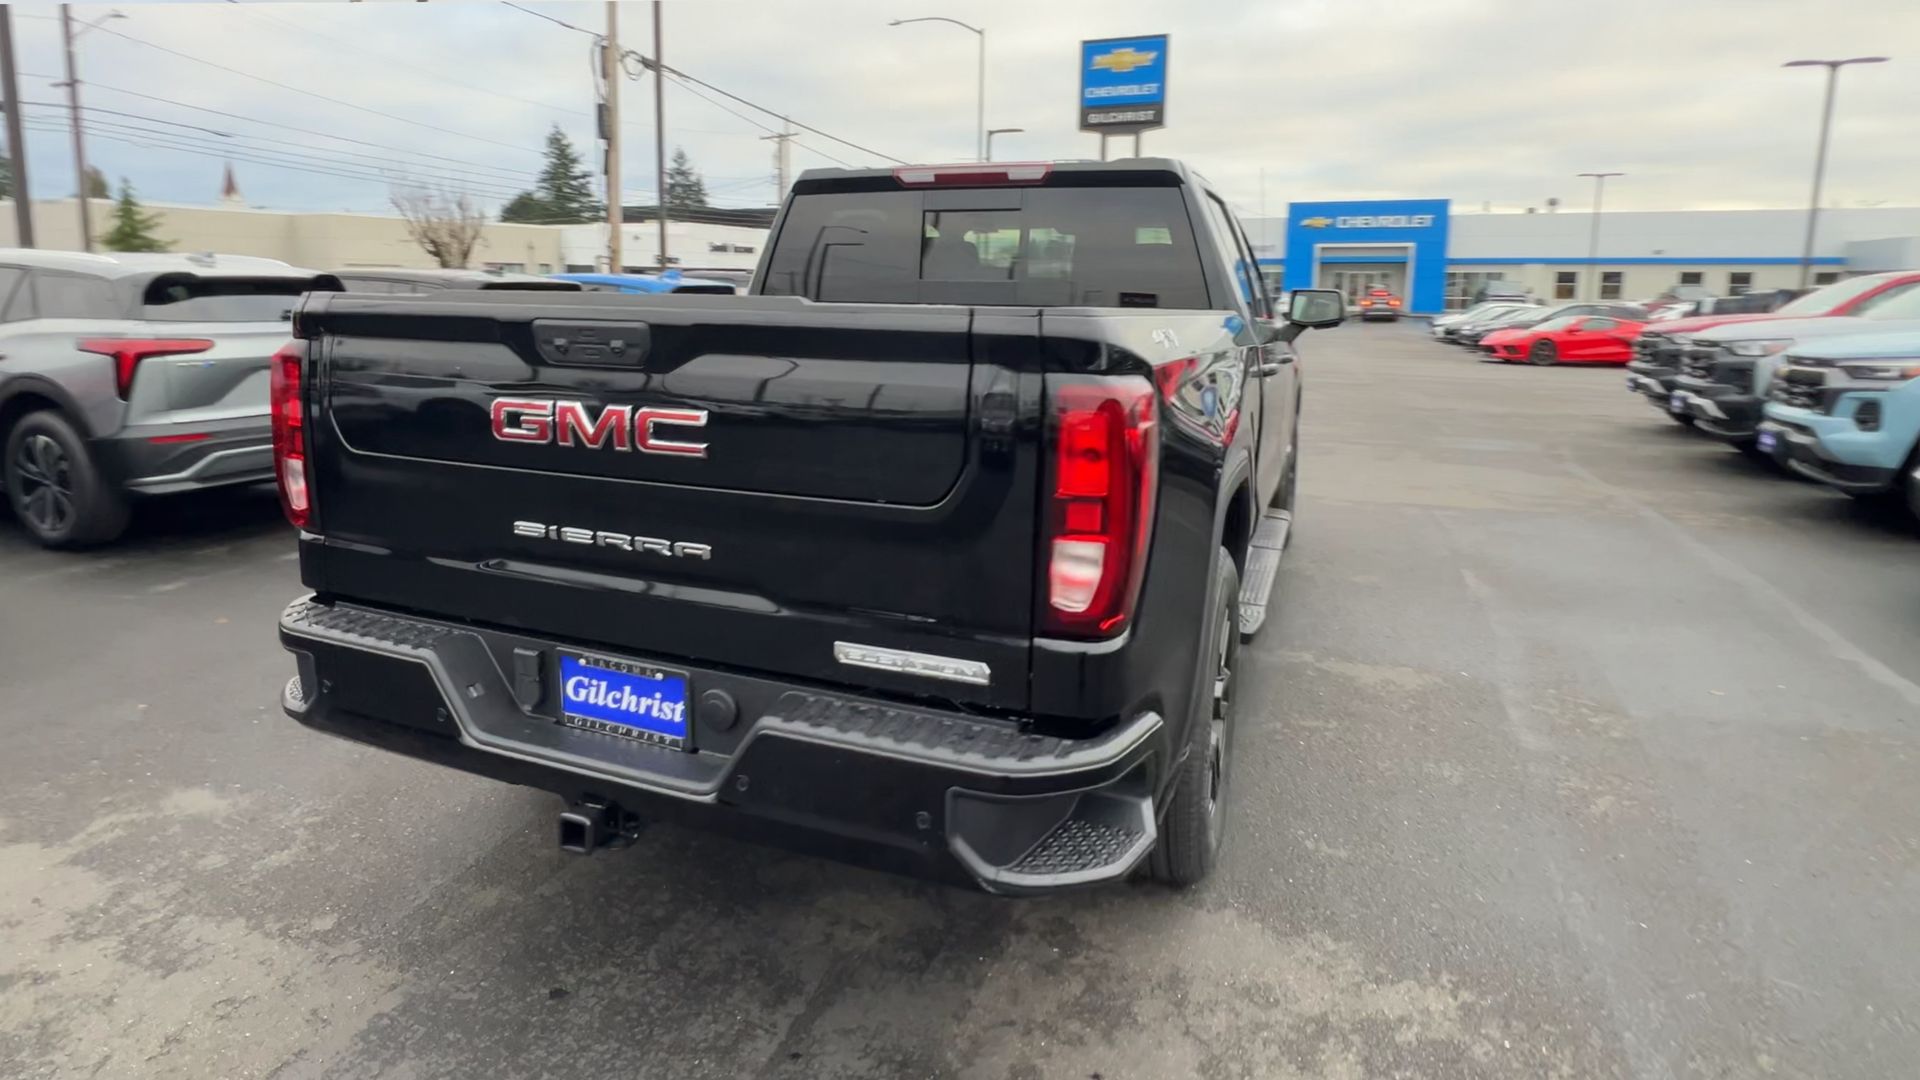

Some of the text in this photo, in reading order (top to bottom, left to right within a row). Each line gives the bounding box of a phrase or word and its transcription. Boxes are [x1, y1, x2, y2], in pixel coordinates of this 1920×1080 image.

[1336, 215, 1435, 228] CHEVROLET
[491, 397, 709, 458] GMC
[513, 520, 712, 560] SIERRA
[588, 658, 653, 676] TACOMA
[565, 675, 686, 723] Gilchrist
[574, 717, 673, 745] GILCHRIST
